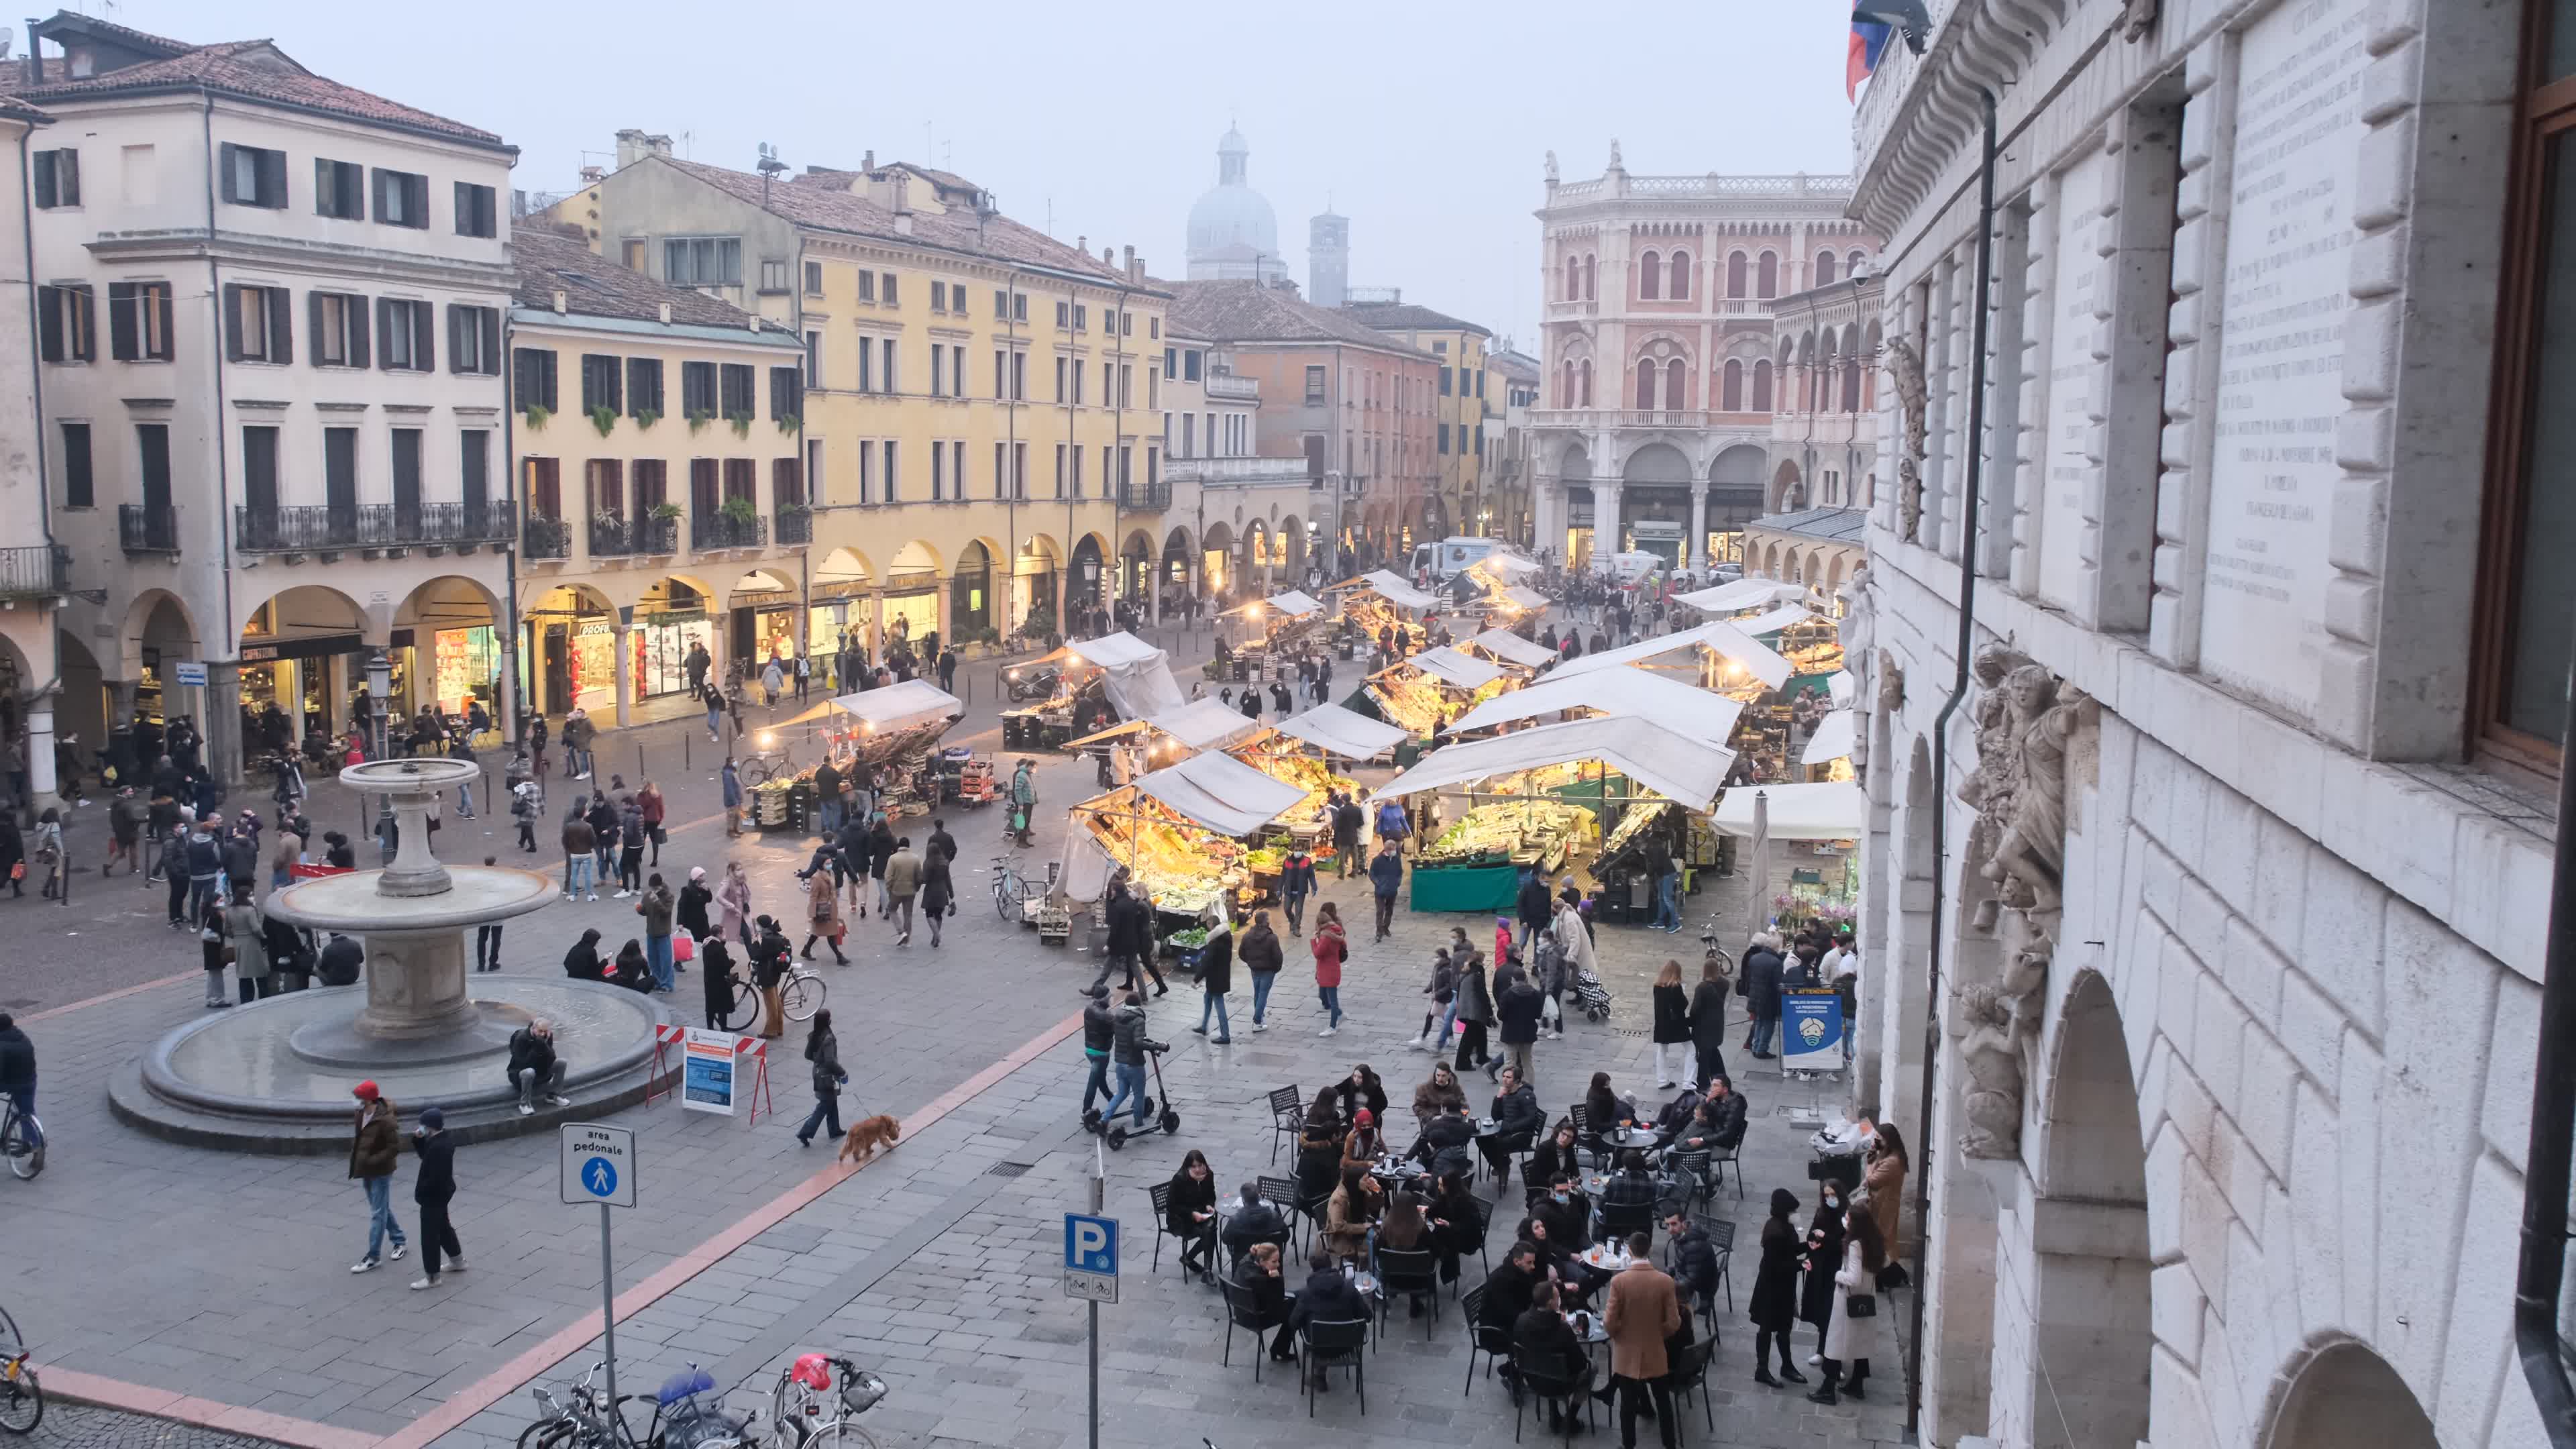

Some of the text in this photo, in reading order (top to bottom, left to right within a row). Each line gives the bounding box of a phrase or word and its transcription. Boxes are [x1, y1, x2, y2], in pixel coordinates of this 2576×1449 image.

[588, 1131, 610, 1140] area
[574, 1142, 623, 1155] pedonale
[1075, 1220, 1106, 1265] P
